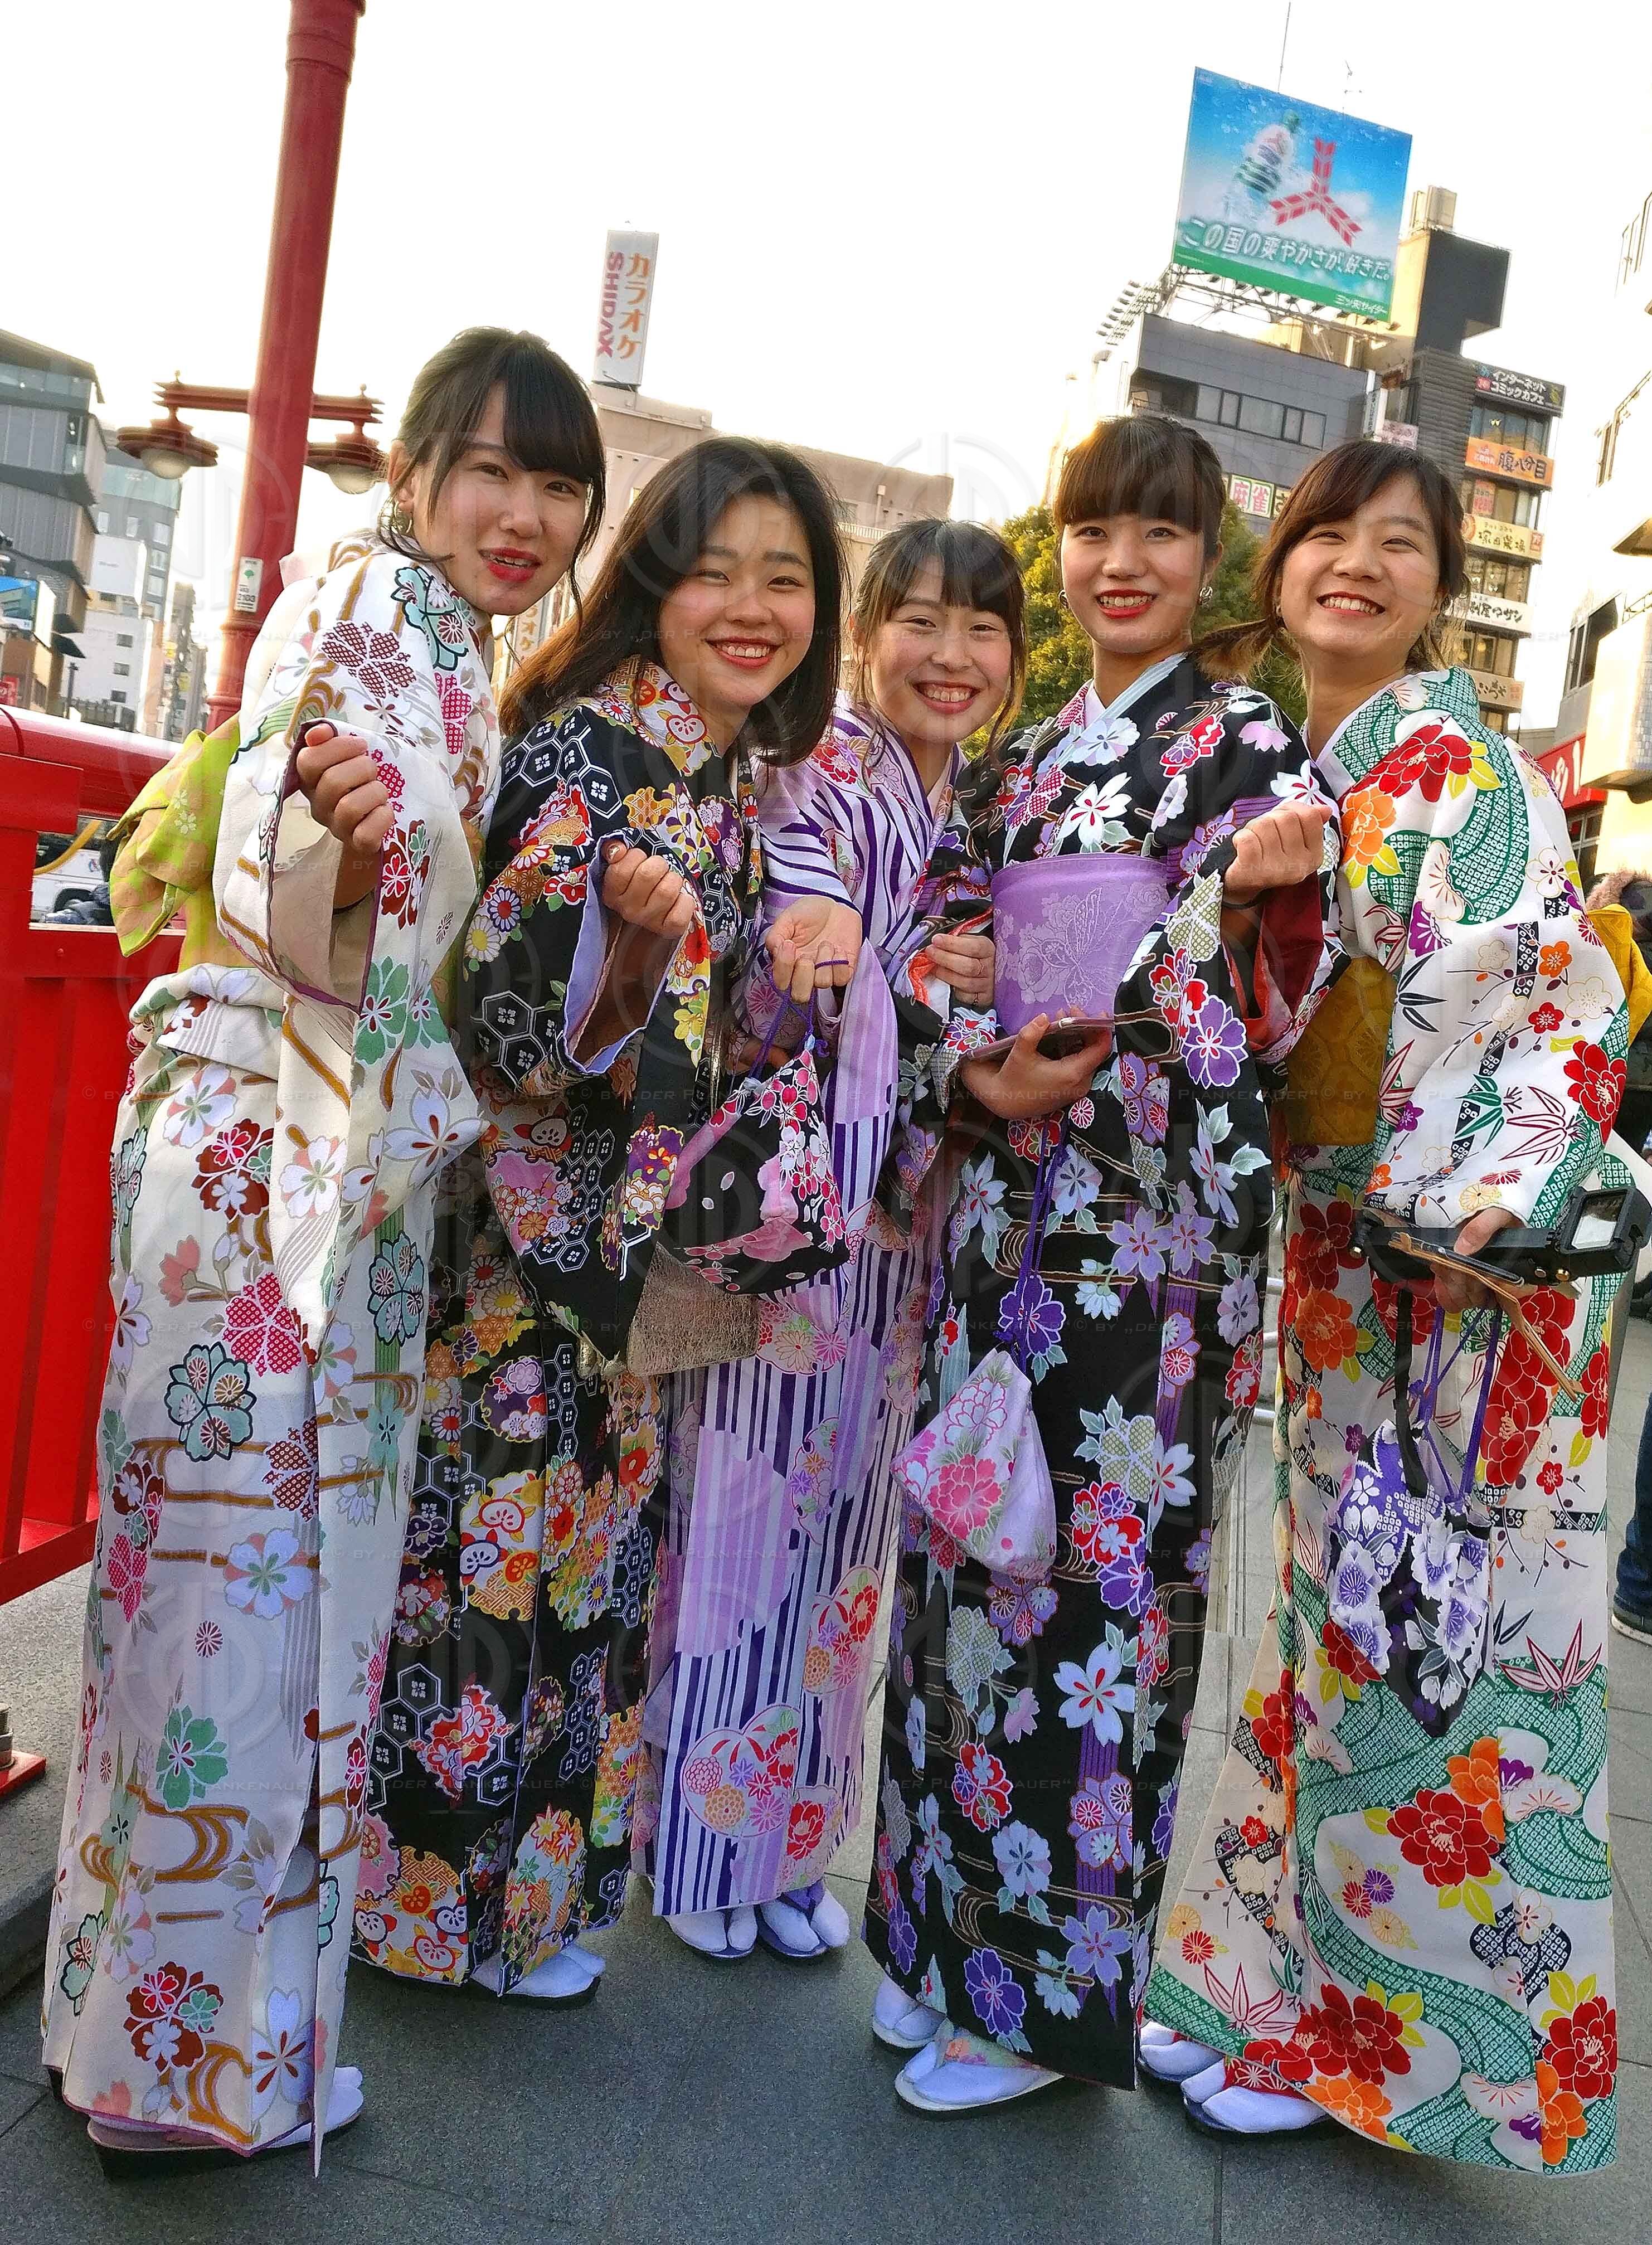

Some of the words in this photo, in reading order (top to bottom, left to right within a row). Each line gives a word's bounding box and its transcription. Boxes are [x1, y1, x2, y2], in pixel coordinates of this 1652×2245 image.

[596, 251, 625, 358] SHIDAX
[617, 253, 651, 359] カラオケ
[1491, 381, 1544, 405] コミックカフェ
